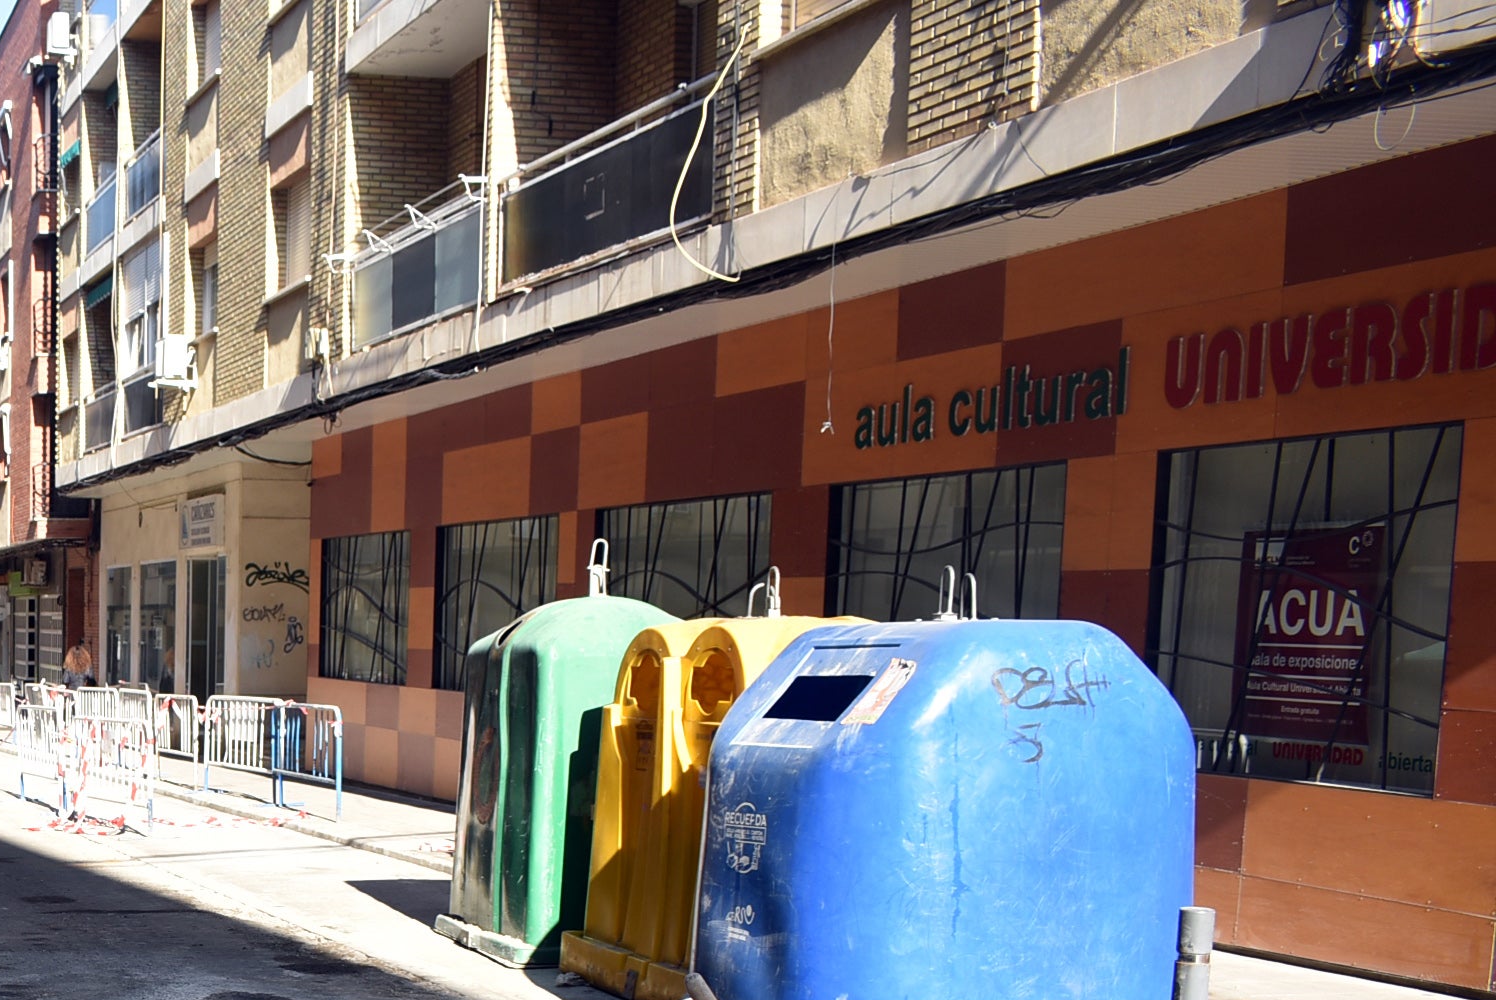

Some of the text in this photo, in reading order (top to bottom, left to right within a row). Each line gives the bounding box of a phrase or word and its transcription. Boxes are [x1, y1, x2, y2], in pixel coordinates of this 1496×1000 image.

[853, 383, 935, 449] aula
[947, 345, 1133, 438] cultural
[1255, 588, 1365, 637] ACUA
[1272, 653, 1286, 667] de
[1288, 653, 1364, 671] exposicione
[1262, 681, 1289, 692] Cultural
